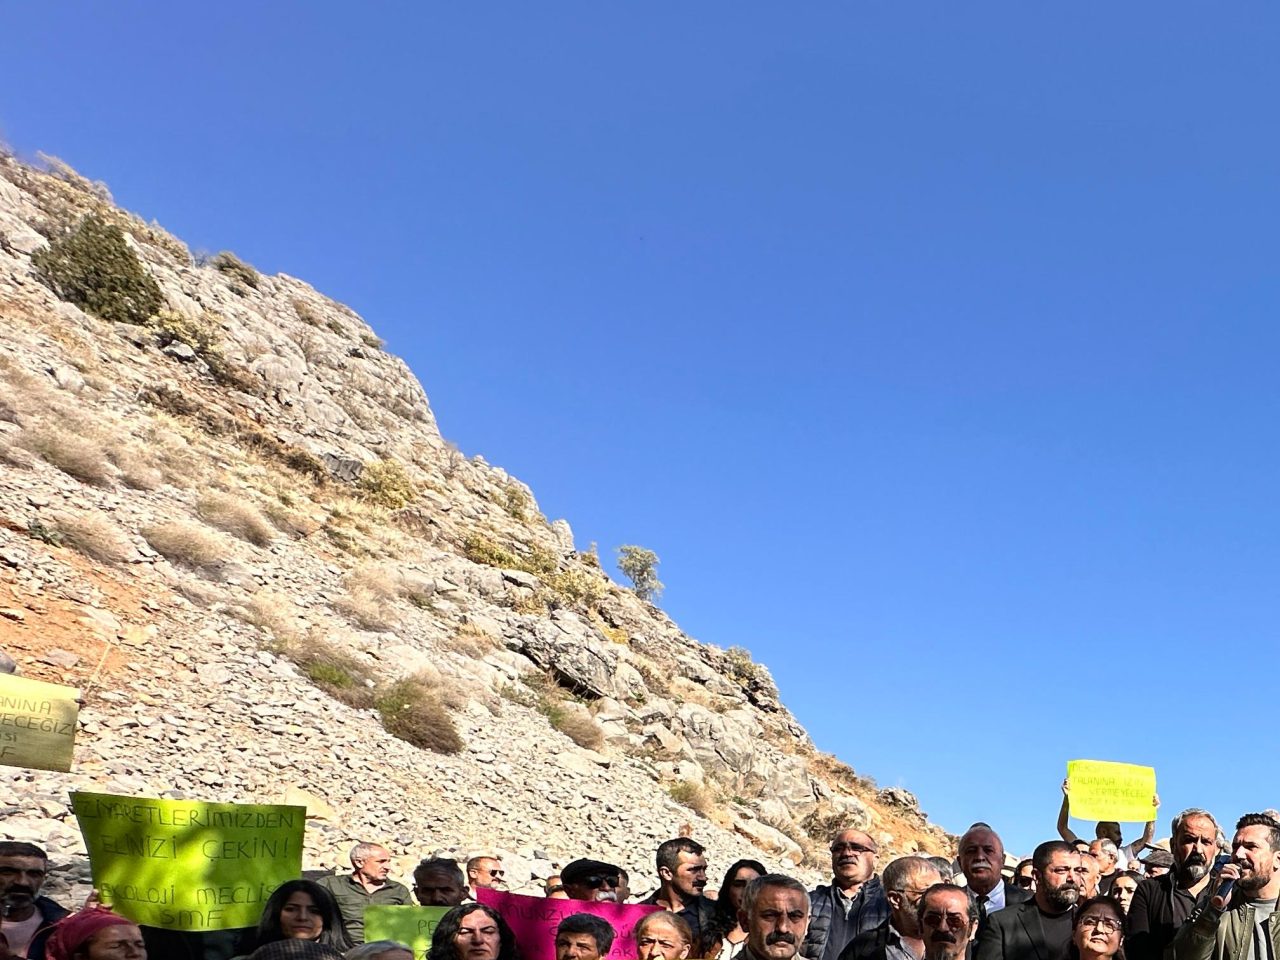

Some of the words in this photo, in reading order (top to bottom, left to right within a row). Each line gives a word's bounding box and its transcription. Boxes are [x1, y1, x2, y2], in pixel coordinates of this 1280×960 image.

[203, 836, 289, 863] ÇEKİN!
[196, 880, 286, 905] MECLİS
[161, 909, 224, 927] SMF
